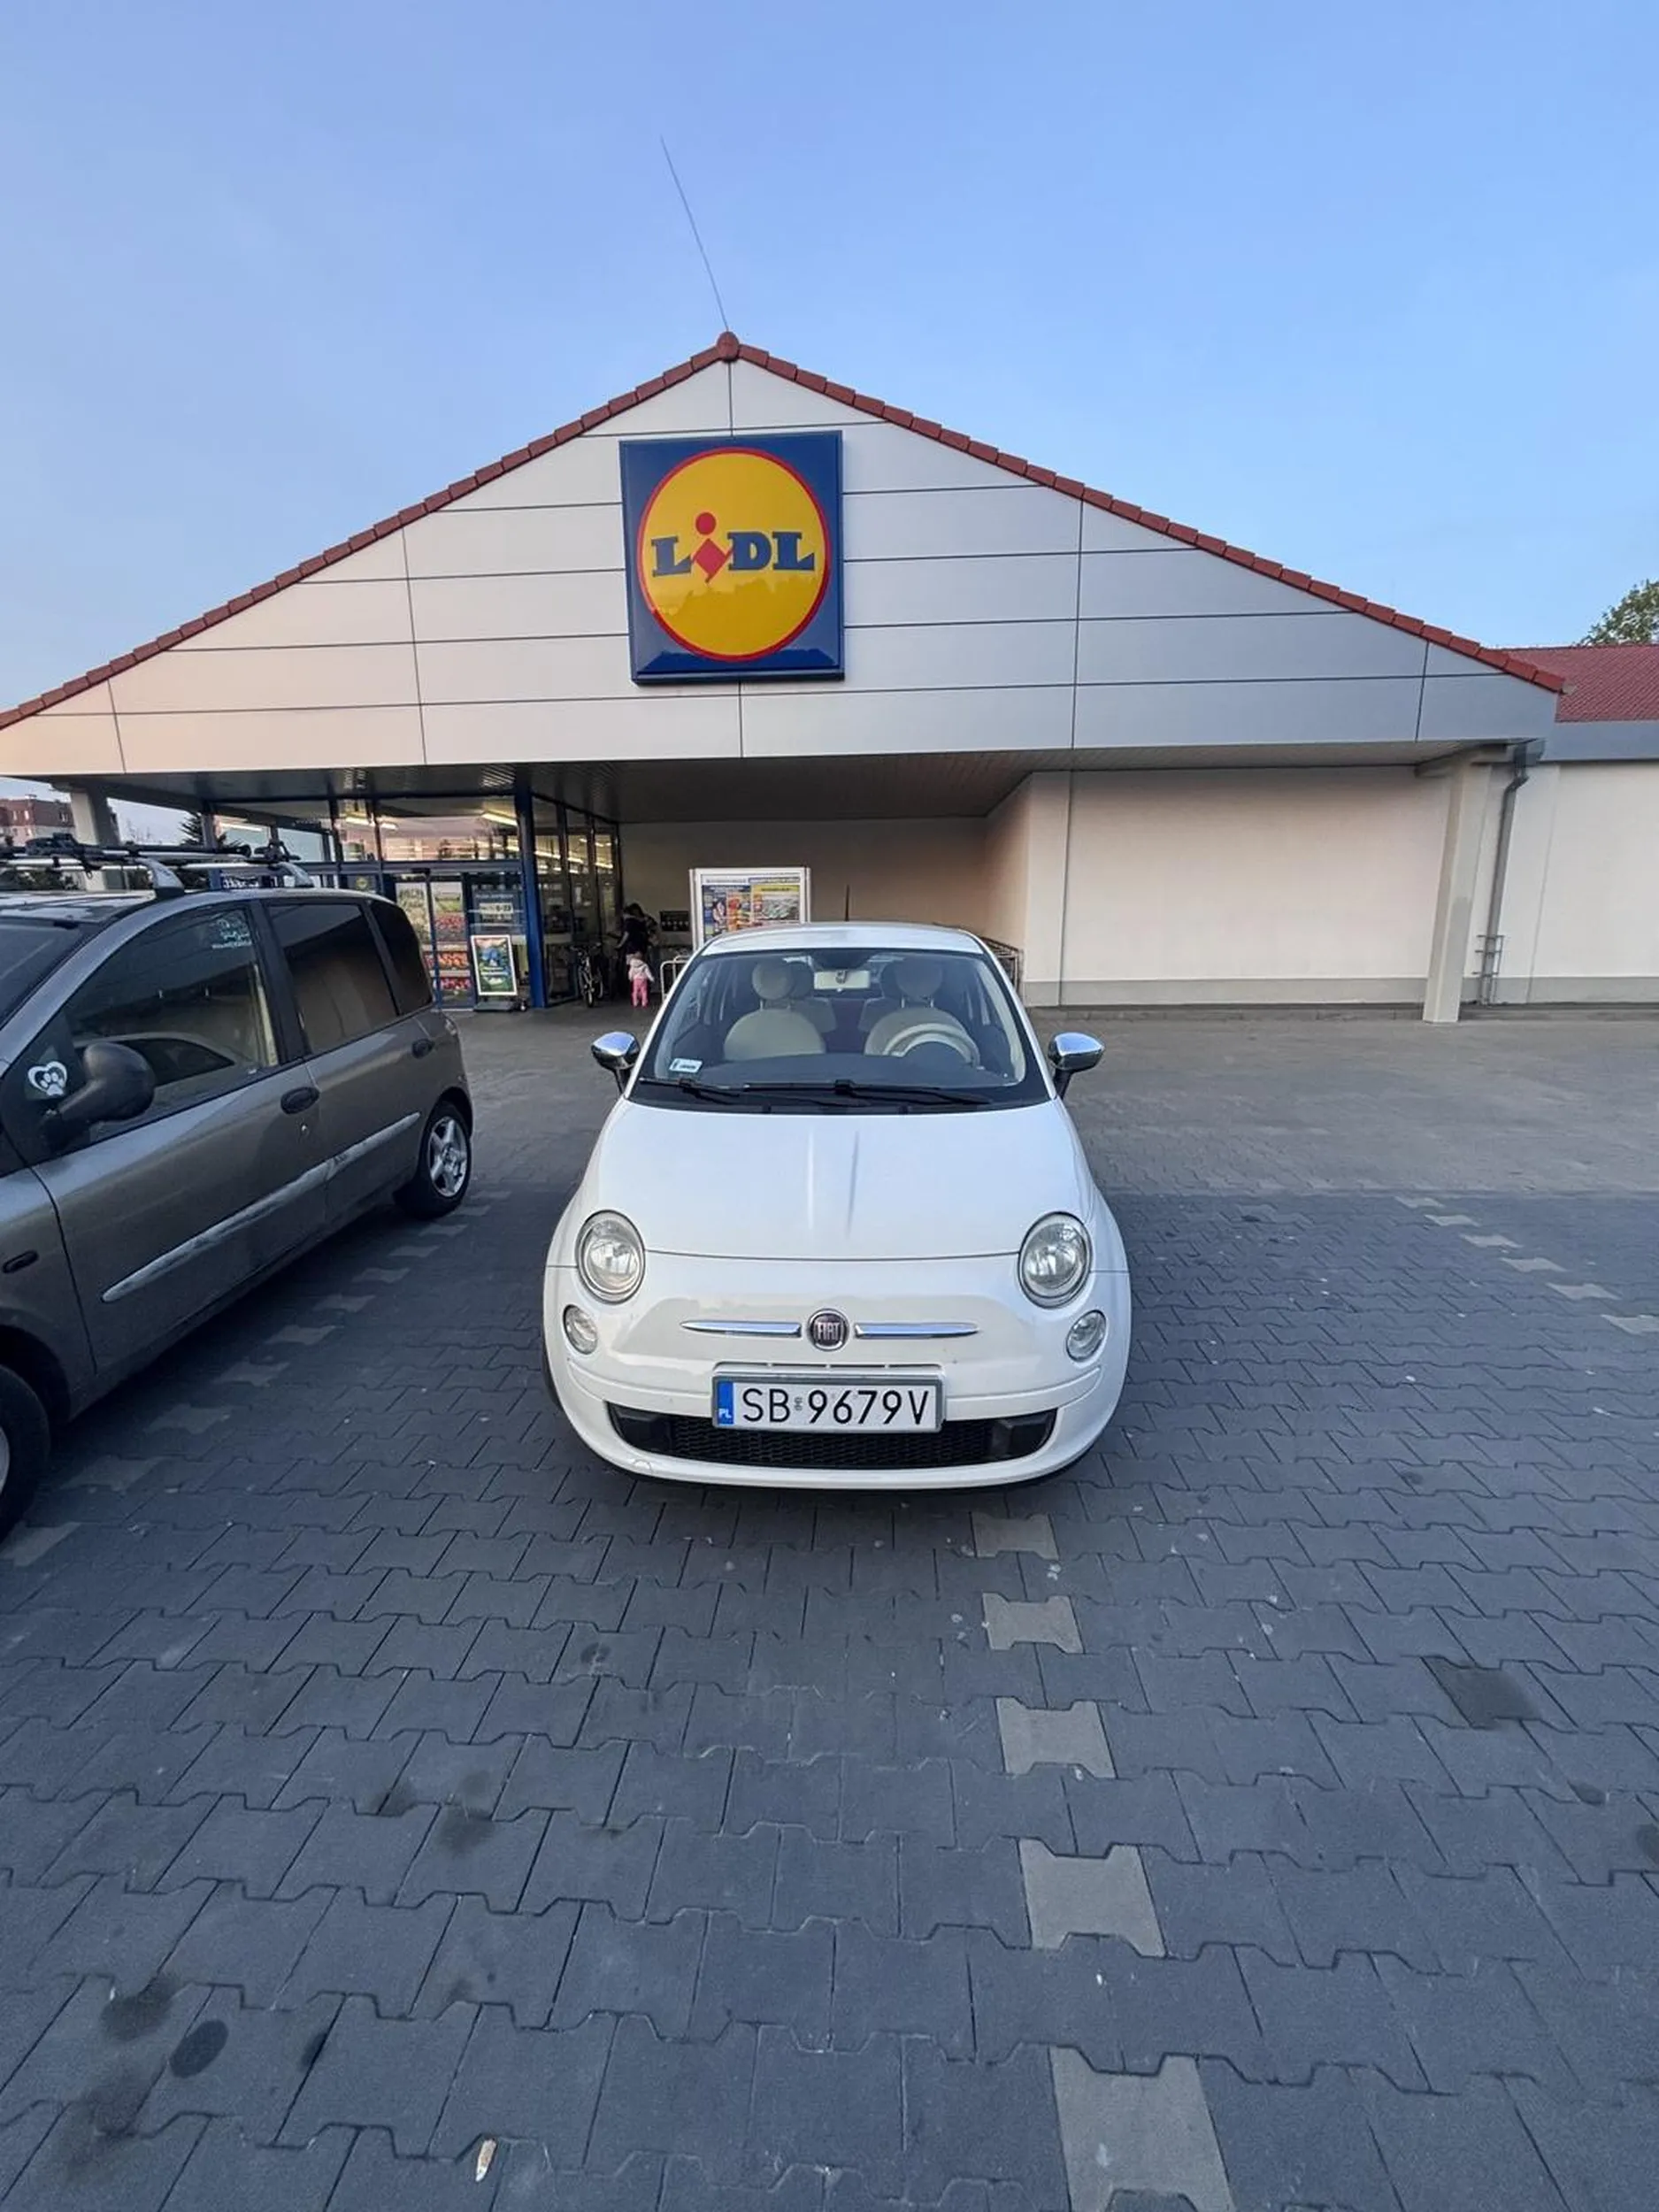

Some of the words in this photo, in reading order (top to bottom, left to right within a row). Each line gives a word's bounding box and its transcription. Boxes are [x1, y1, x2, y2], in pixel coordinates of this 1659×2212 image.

[817, 1321, 841, 1341] FIAT
[718, 1408, 732, 1419] PL
[741, 1387, 791, 1424] SB
[807, 1389, 929, 1425] 9679V
